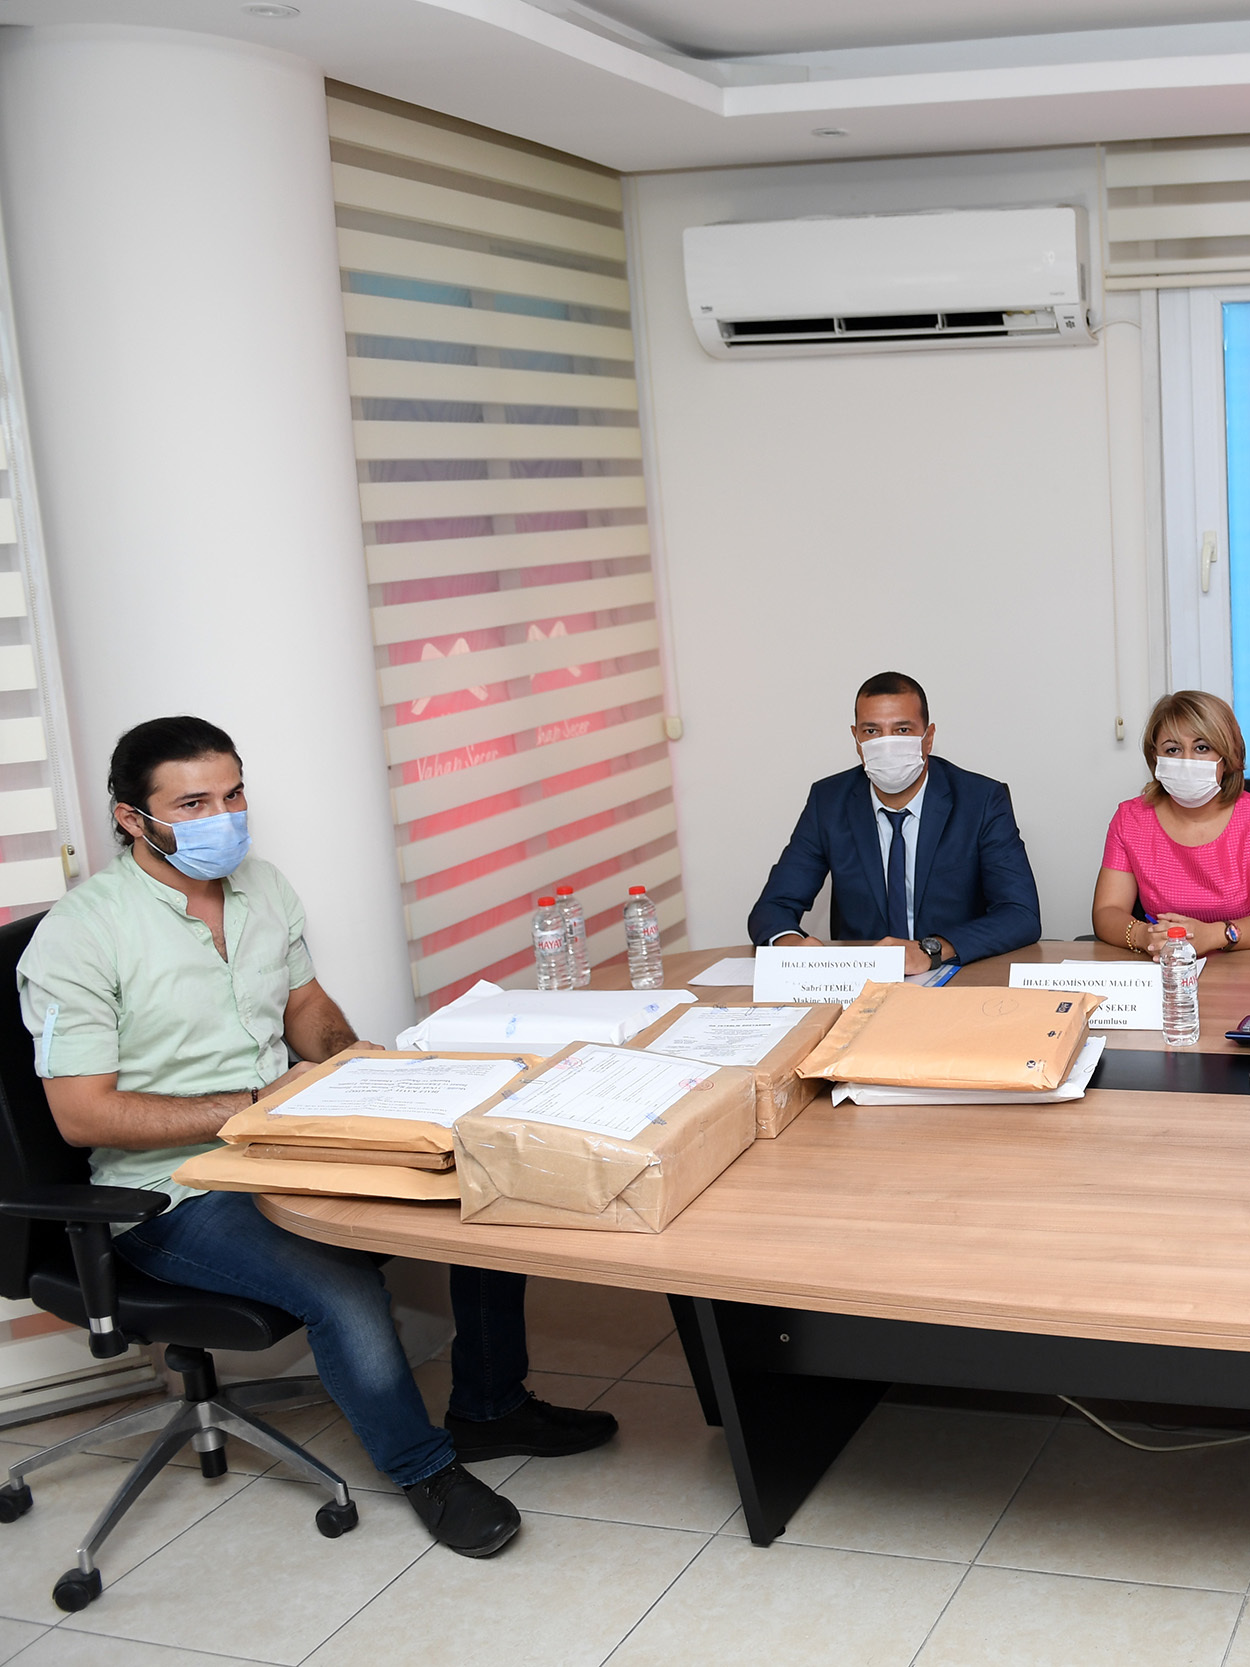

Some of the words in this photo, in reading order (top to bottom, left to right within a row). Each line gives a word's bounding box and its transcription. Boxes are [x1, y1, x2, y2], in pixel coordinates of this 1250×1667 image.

[538, 938, 562, 950] HAYAT
[781, 960, 806, 968] İHALE
[808, 960, 851, 968] KOMİSYON
[853, 960, 876, 968] ÜYESİ
[801, 983, 822, 991] Sabri
[824, 984, 854, 992] TEMEL
[1023, 978, 1050, 986] İHALE
[1053, 978, 1107, 987] KOMİSYONU
[1110, 979, 1132, 987] MALİ
[1135, 978, 1153, 988] ÜYE
[823, 996, 857, 1004] Mühendi
[1106, 1004, 1137, 1013] ŞEKER
[1087, 1017, 1128, 1025] orumlusu
